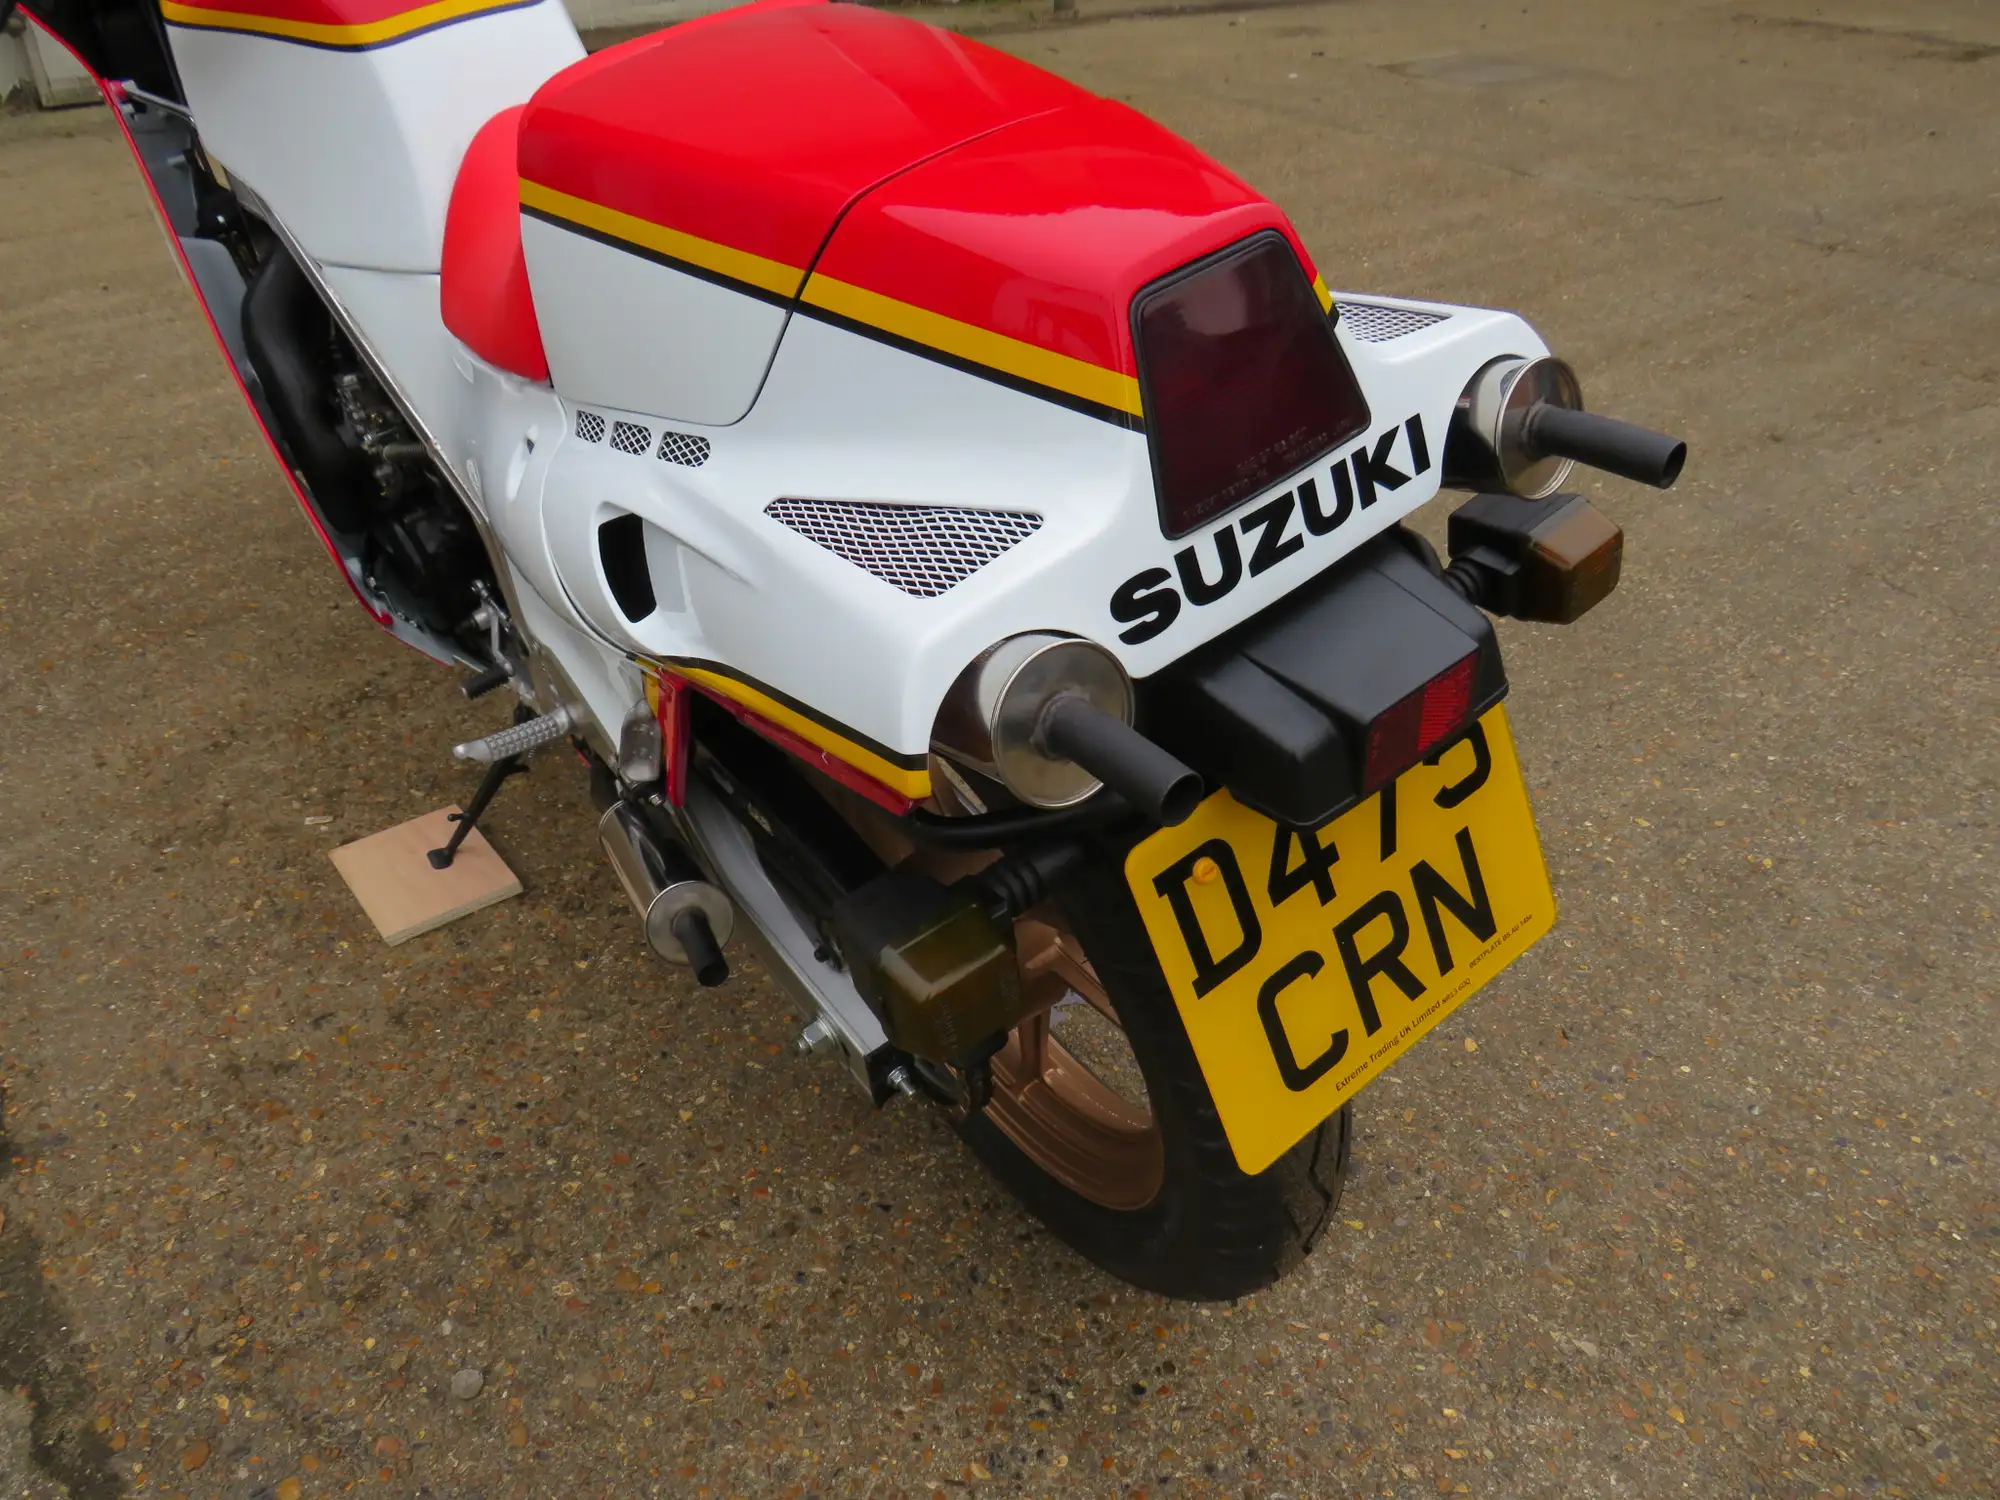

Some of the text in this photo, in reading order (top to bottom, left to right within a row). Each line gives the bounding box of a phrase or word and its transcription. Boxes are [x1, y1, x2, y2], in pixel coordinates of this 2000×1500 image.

[1110, 412, 1431, 645] SUZUKI
[1257, 826, 1498, 1092] CRN
[1335, 1061, 1369, 1092] Extreme
[1369, 1034, 1400, 1063] Trading
[1399, 1024, 1412, 1039] UK
[1411, 1000, 1441, 1029] Limited
